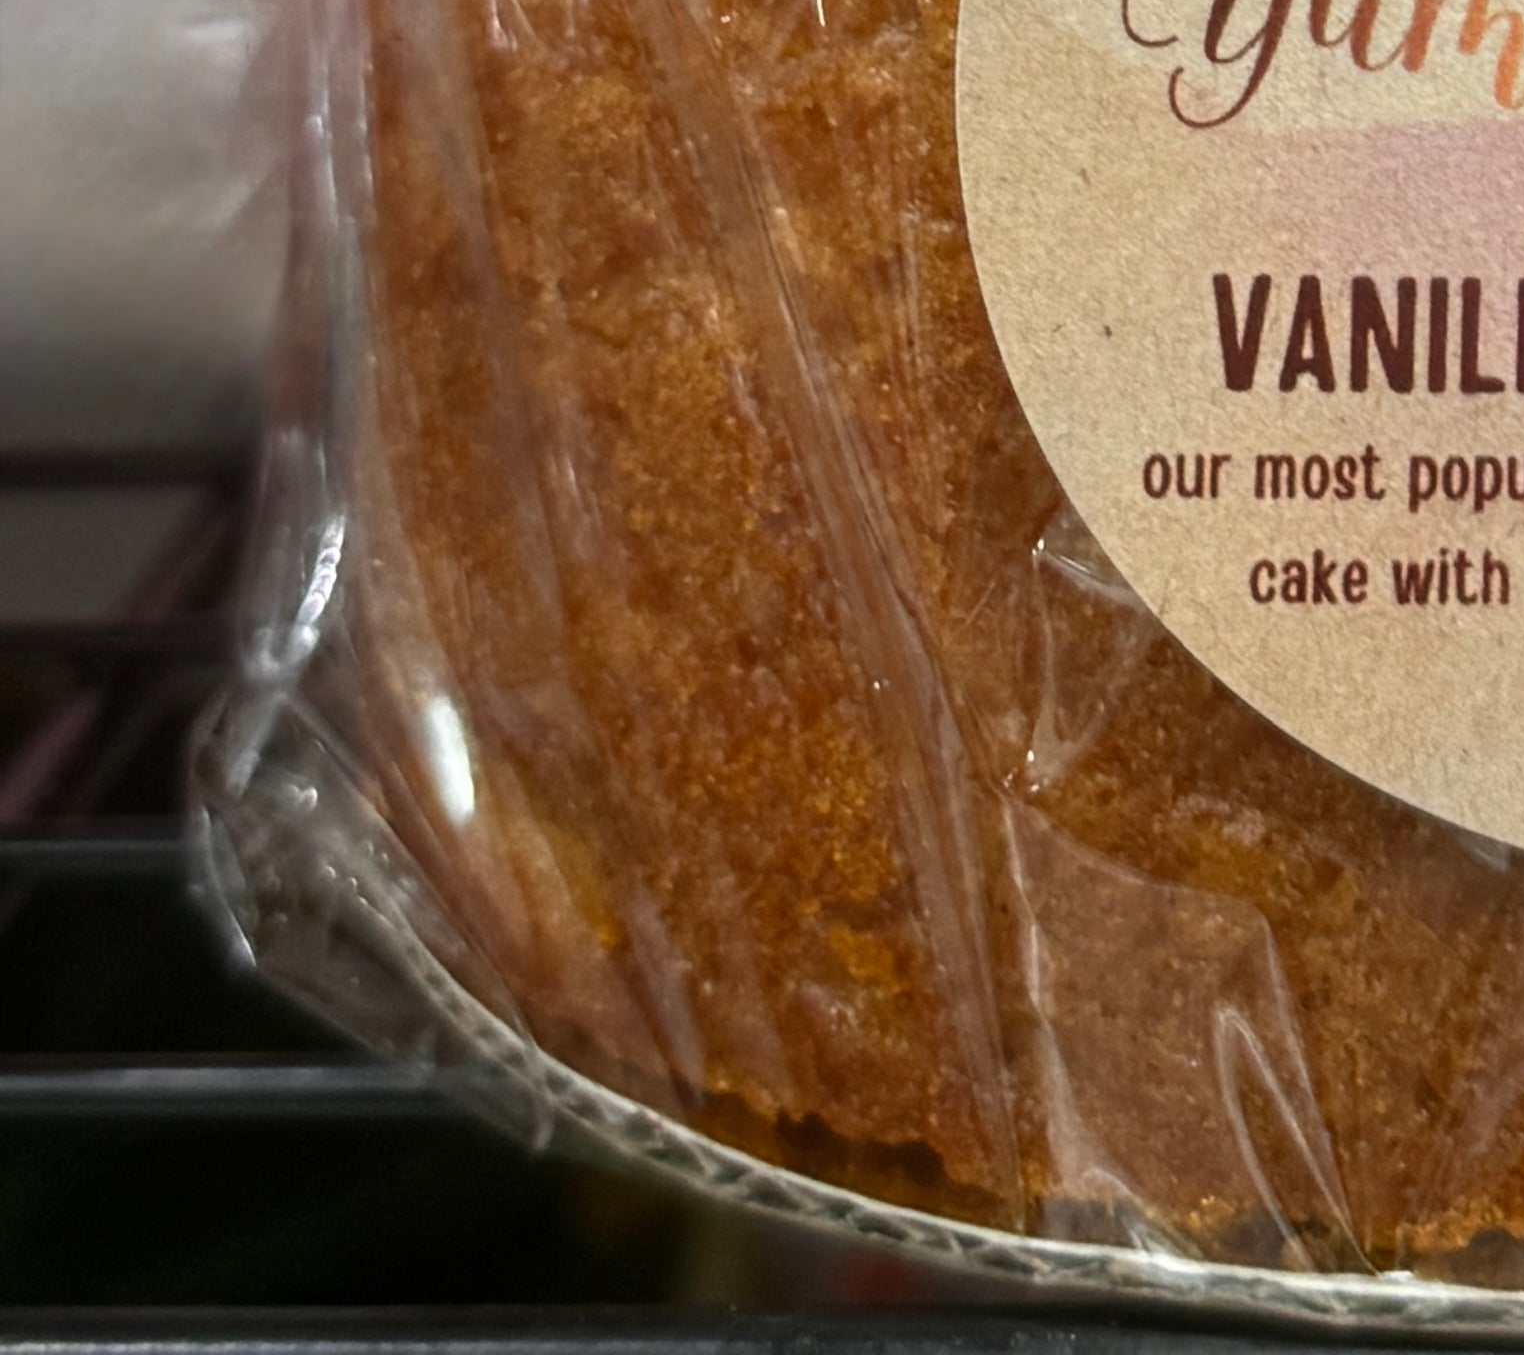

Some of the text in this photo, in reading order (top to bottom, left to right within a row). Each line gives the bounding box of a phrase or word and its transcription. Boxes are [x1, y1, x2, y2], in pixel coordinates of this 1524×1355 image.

[1141, 452, 1232, 499] our
[1252, 444, 1386, 502] most
[1248, 548, 1369, 606] cake
[1391, 548, 1511, 606] with
